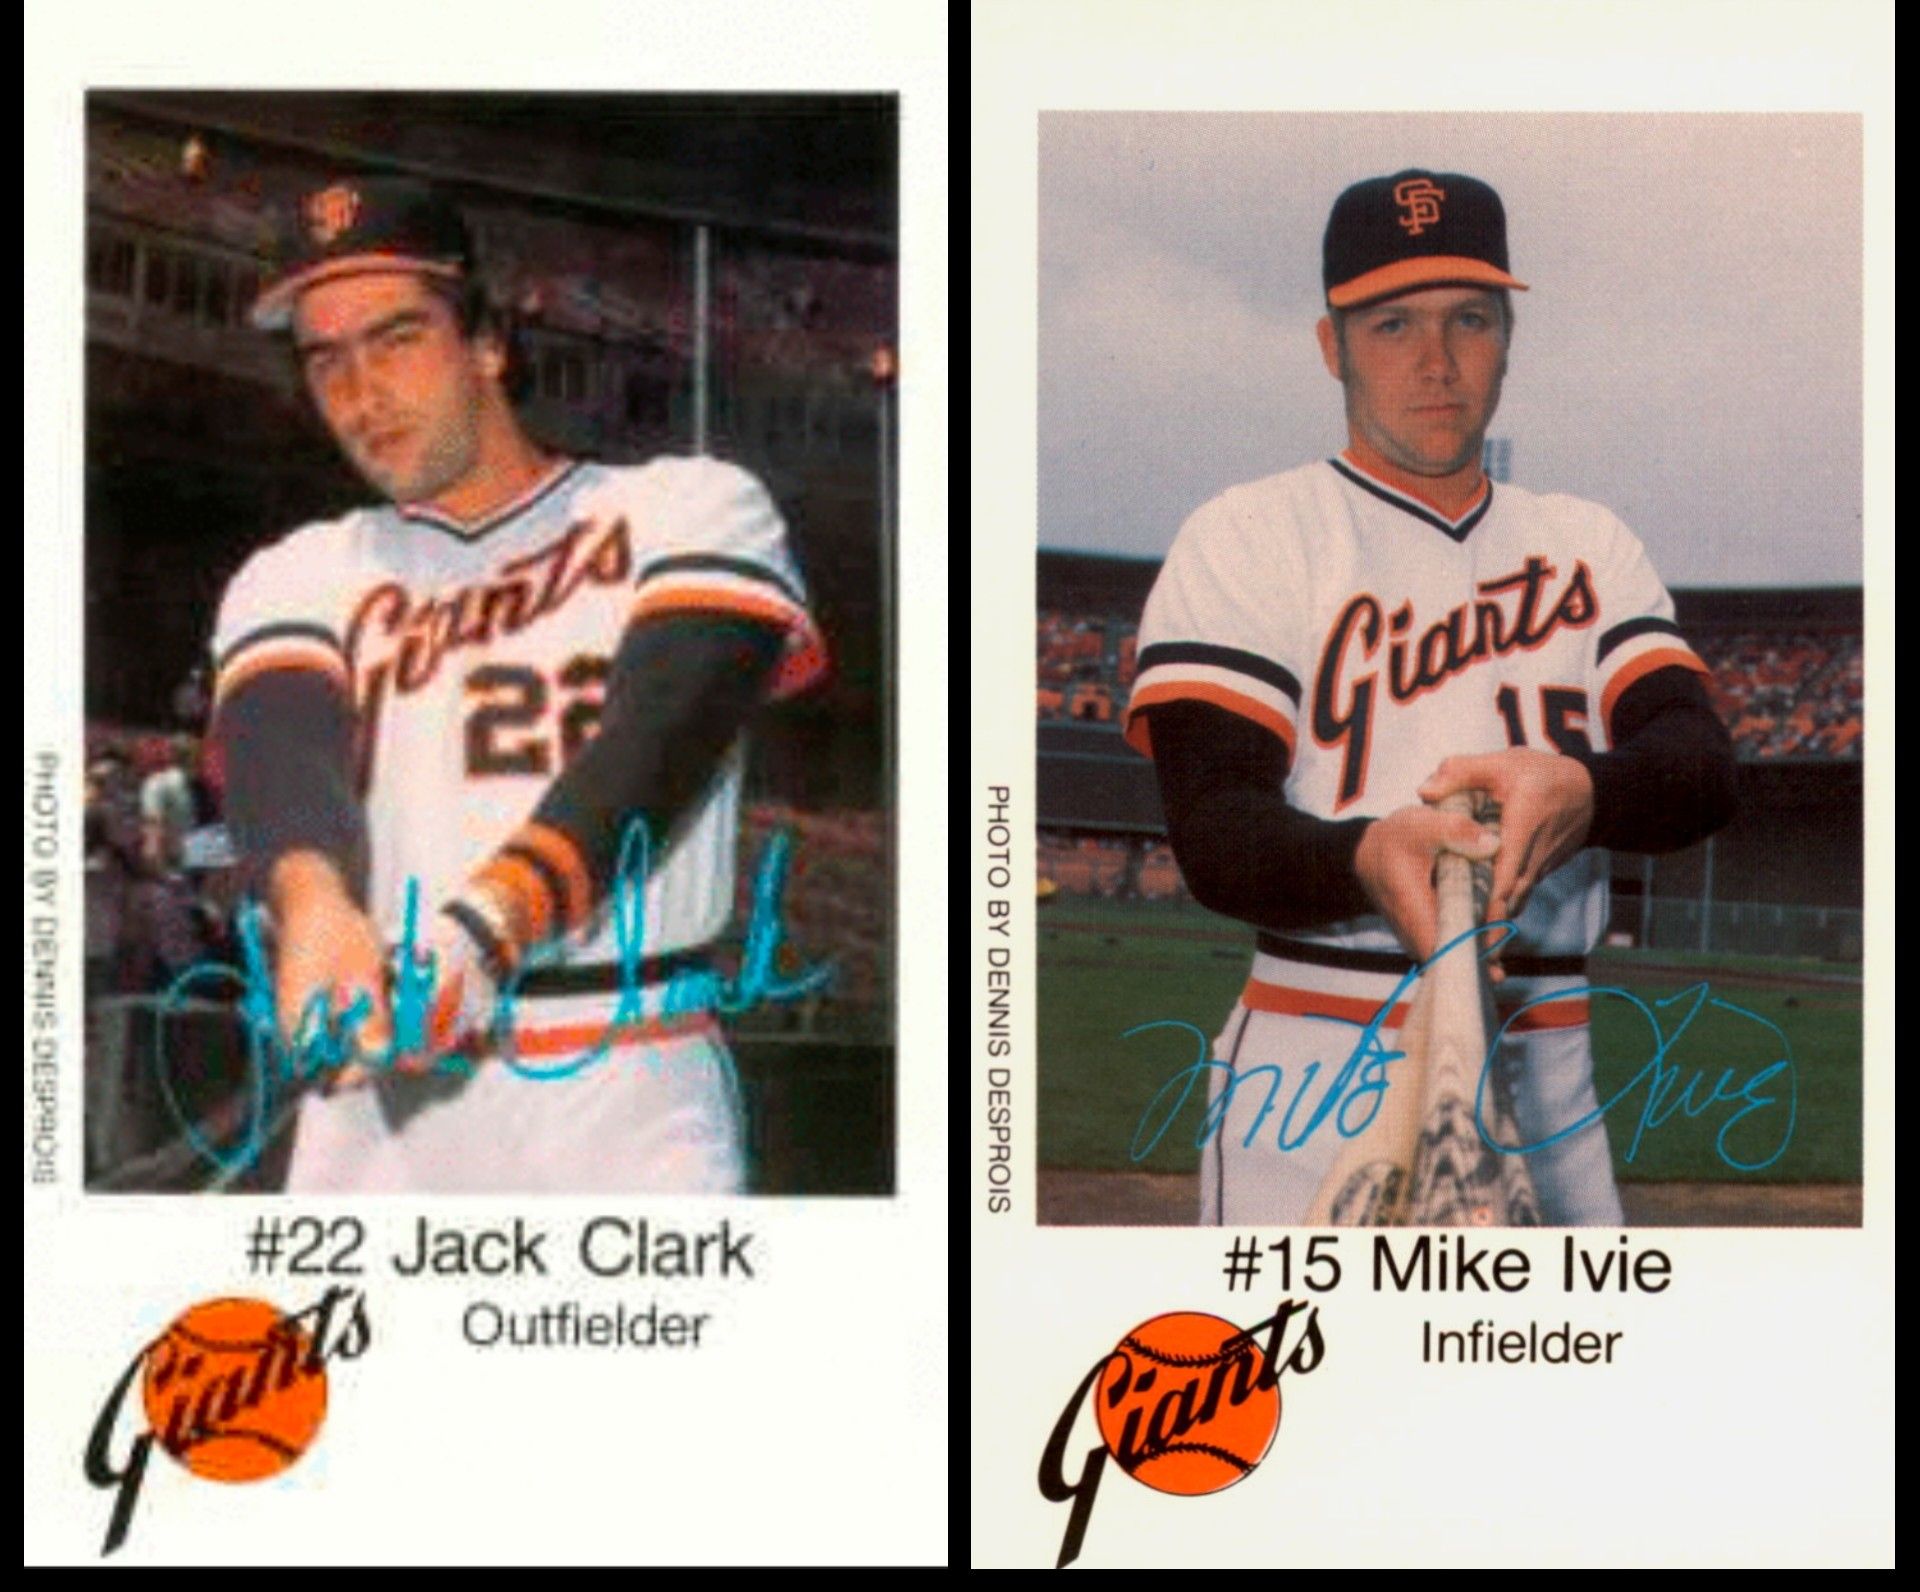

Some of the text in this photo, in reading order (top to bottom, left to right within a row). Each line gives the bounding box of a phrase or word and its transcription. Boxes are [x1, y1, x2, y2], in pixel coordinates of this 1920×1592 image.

[343, 514, 632, 805] Giants
[1311, 554, 1600, 814] Giants
[33, 752, 58, 858] PHOTO
[33, 870, 58, 906] BY
[33, 917, 58, 1031] DENNIS
[987, 786, 1011, 1214] PHOTO BY DENNIS DESPROIS
[247, 1216, 754, 1277] #22 Jack Clark
[1222, 1233, 1672, 1294] #15 Mike Ivie
[462, 1302, 711, 1347] Outfielder
[1422, 1319, 1624, 1365] Infielder
[83, 1286, 371, 1557] Giants
[1037, 1298, 1326, 1569] Giants
